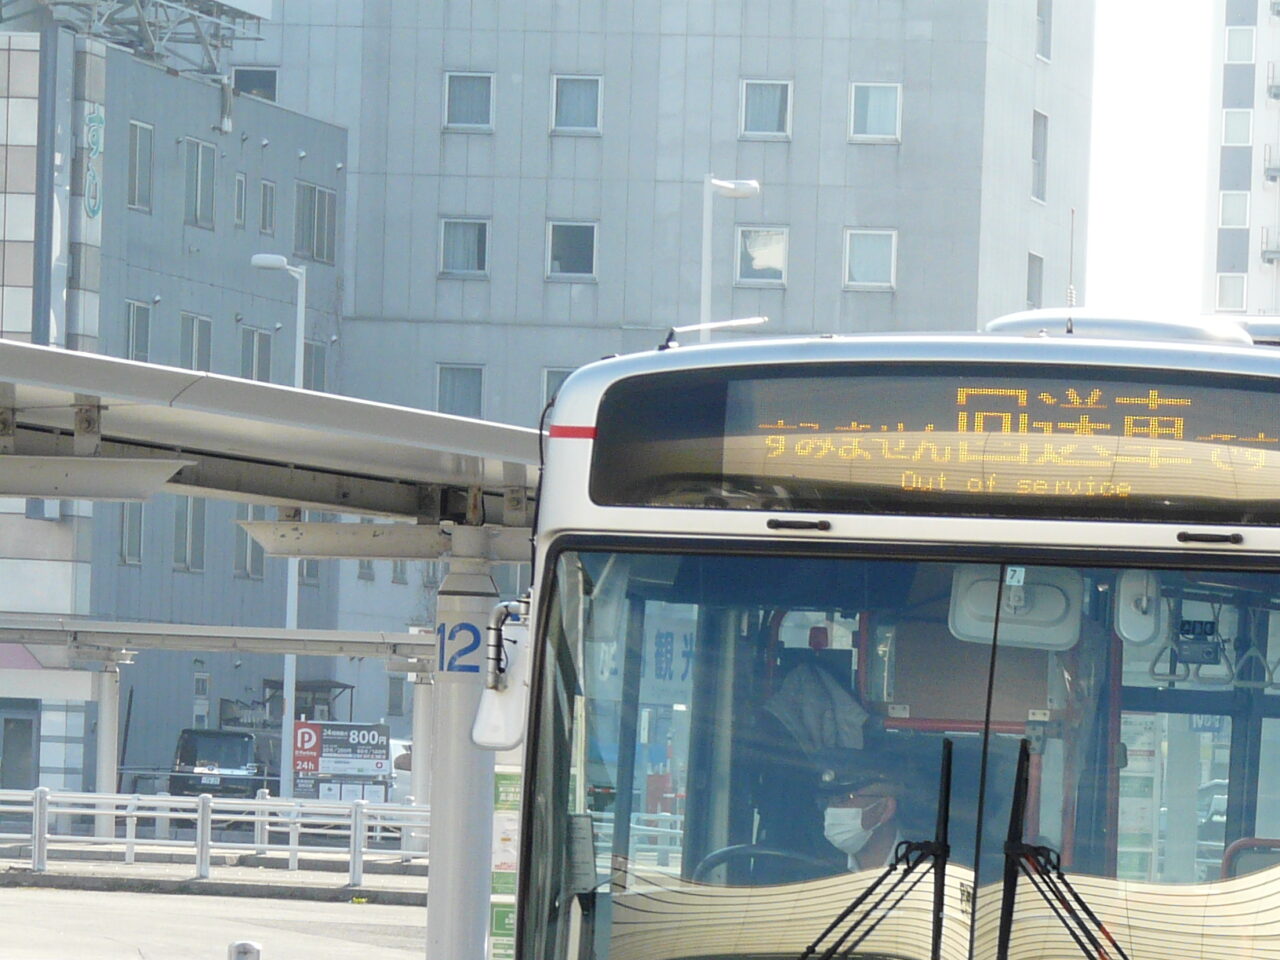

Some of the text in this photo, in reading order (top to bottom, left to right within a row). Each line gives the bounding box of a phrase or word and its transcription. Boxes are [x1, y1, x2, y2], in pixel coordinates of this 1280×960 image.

[901, 470, 1132, 498] Out of service
[436, 621, 482, 673] 12
[348, 730, 387, 745] 800円
[296, 761, 315, 770] 24h
